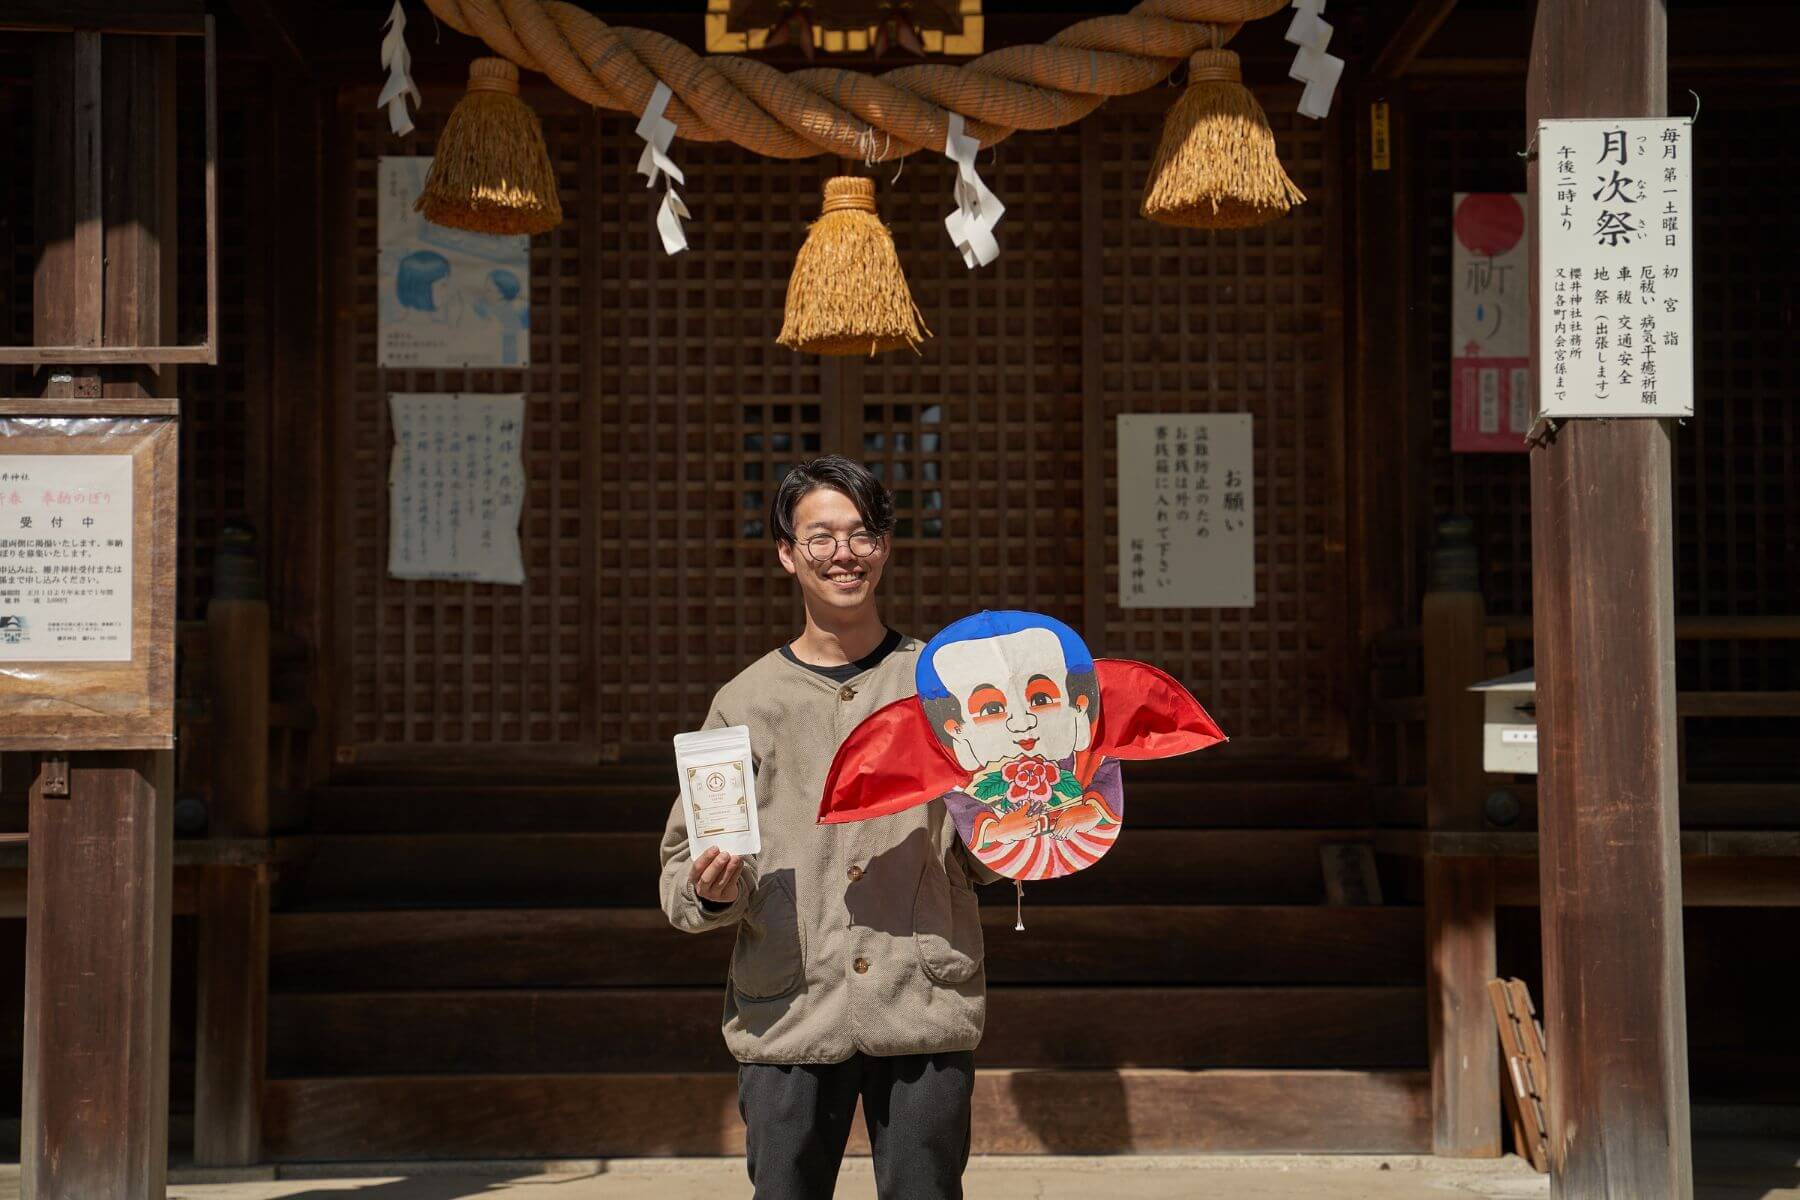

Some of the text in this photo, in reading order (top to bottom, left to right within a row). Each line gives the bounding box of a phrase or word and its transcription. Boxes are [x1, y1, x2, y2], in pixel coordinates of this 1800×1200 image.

[1556, 145, 1577, 231] 午後二時より
[1592, 129, 1638, 247] 月次祭
[1593, 266, 1610, 305] 地祭
[1662, 264, 1679, 346] 初宮詣
[1553, 267, 1567, 401] 又は各町内会宮係まで
[1617, 314, 1633, 385] 交通安全
[1640, 314, 1657, 405] 病気平癒祈願
[0, 472, 30, 481] 井神社
[1223, 469, 1244, 532] お願い
[20, 516, 94, 529] 受付中
